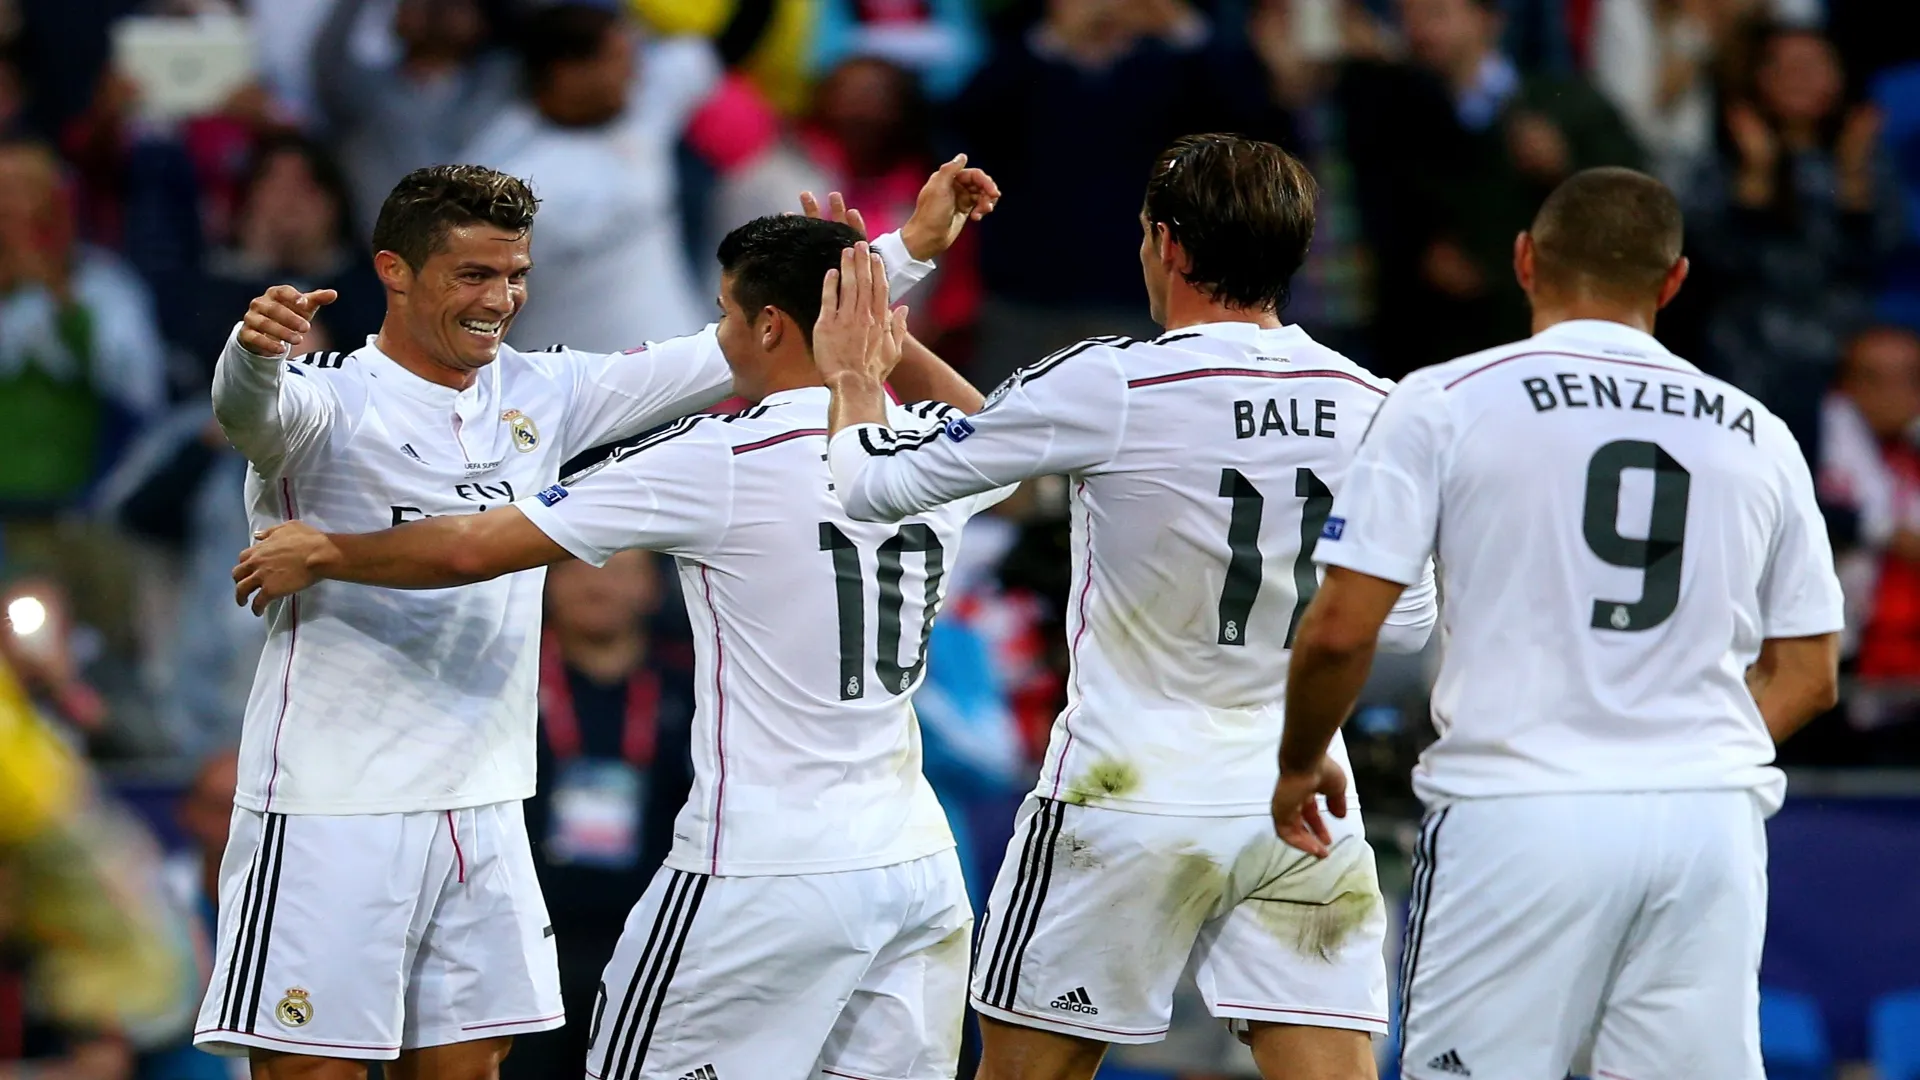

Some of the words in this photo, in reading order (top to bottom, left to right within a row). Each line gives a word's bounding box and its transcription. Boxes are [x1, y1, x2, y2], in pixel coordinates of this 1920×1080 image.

[1233, 398, 1336, 439] BALE
[1523, 373, 1756, 446] BENZEMA
[1217, 468, 1334, 649] 11
[1582, 439, 1691, 633] 9
[818, 521, 945, 701] 10
[1050, 1000, 1099, 1015] adidas
